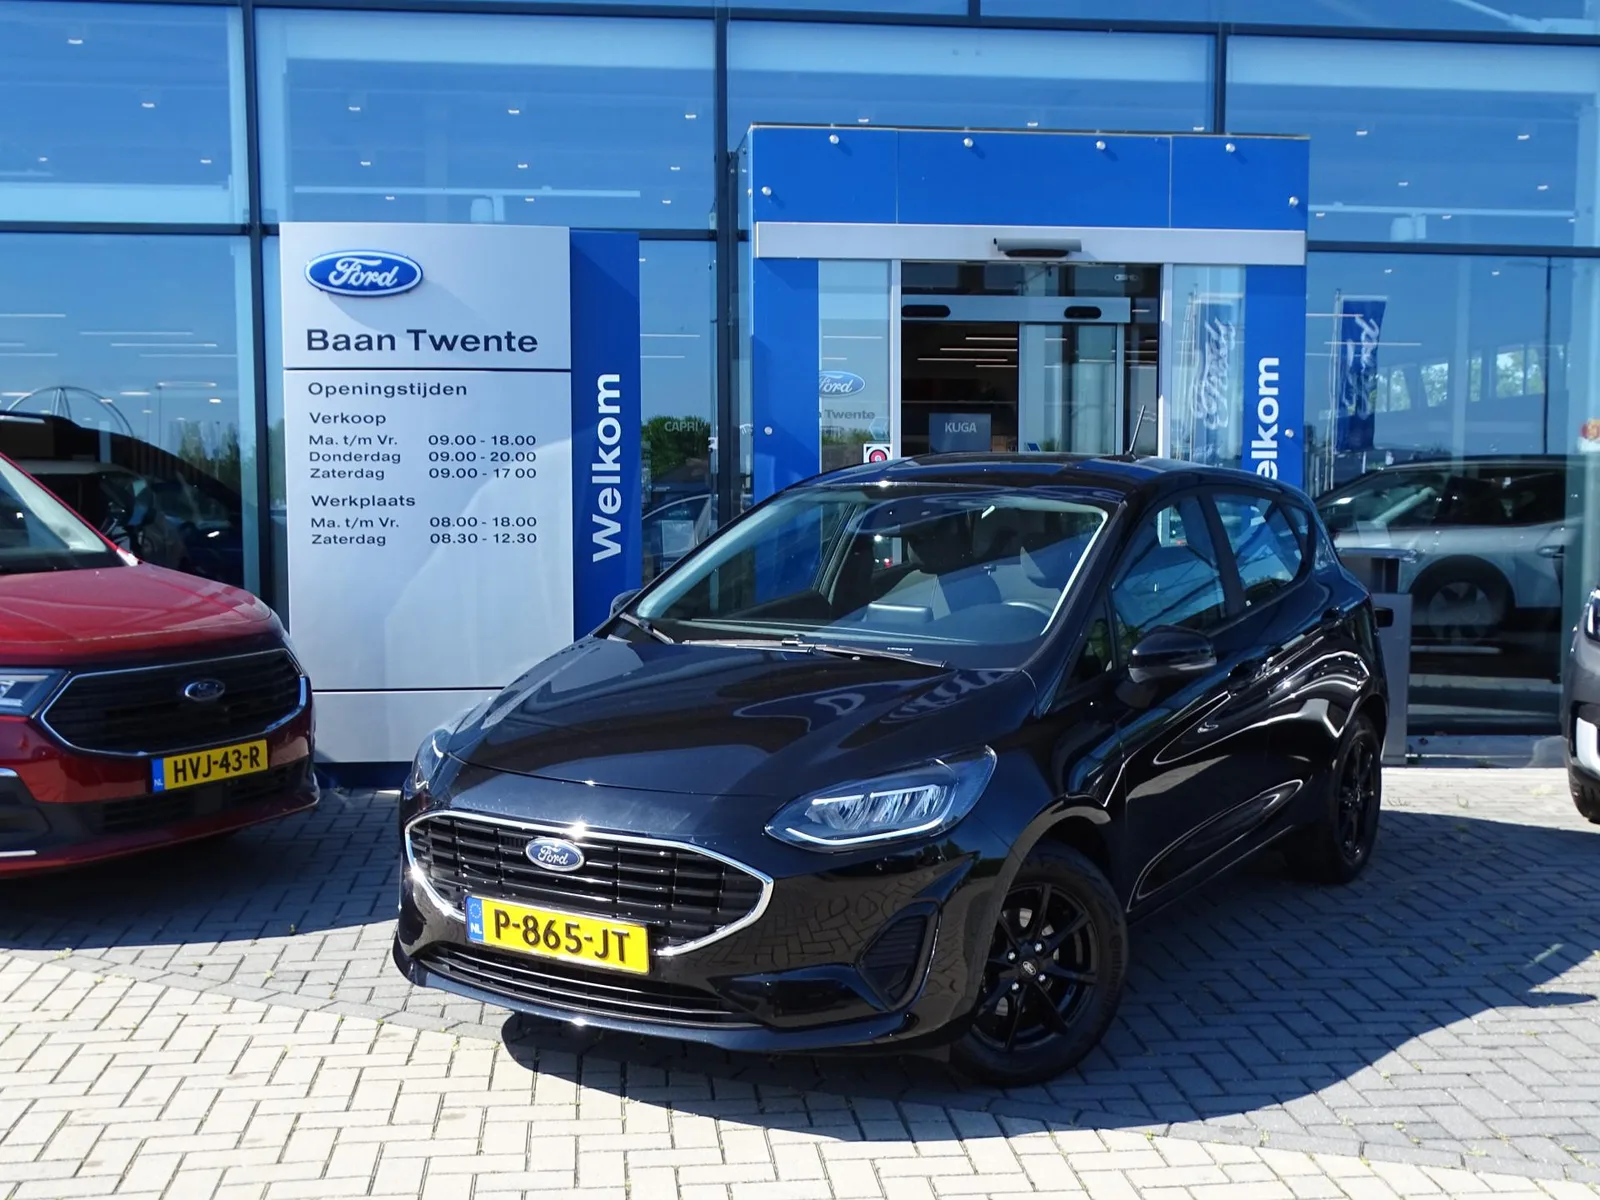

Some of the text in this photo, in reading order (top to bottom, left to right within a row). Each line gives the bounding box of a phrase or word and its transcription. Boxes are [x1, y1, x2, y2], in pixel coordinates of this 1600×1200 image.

[328, 257, 399, 287] Ford
[306, 328, 539, 353] Baan Twente
[307, 381, 468, 399] Openingstijden
[308, 411, 387, 426] Verkoop
[825, 409, 876, 420] Twente
[1250, 357, 1279, 480] elkom
[944, 422, 977, 433] KUGA
[308, 434, 339, 446] Ma.
[342, 434, 373, 447] t/m
[376, 434, 398, 446] Vr.
[427, 434, 477, 446] 09.00
[490, 434, 537, 446] 18.00
[309, 450, 401, 464] Donderdag
[428, 451, 477, 462] 09.00
[489, 451, 537, 463] 20.00
[309, 467, 385, 481] Zaterdag
[428, 467, 478, 479] 09.00
[592, 374, 621, 562] Welkom
[310, 494, 416, 509] Werkplaats
[310, 516, 341, 529] Ma.
[344, 516, 374, 529] t/m
[378, 516, 400, 529] Vr.
[429, 516, 478, 528] 08.00
[491, 515, 538, 528] 18.00
[311, 533, 387, 547] Zaterdag
[429, 533, 478, 545] 08.30
[492, 532, 538, 545] 12.30
[173, 745, 260, 783] HVJ-43-R
[537, 845, 569, 865] Ford
[470, 908, 630, 962] NL P-865-JT
